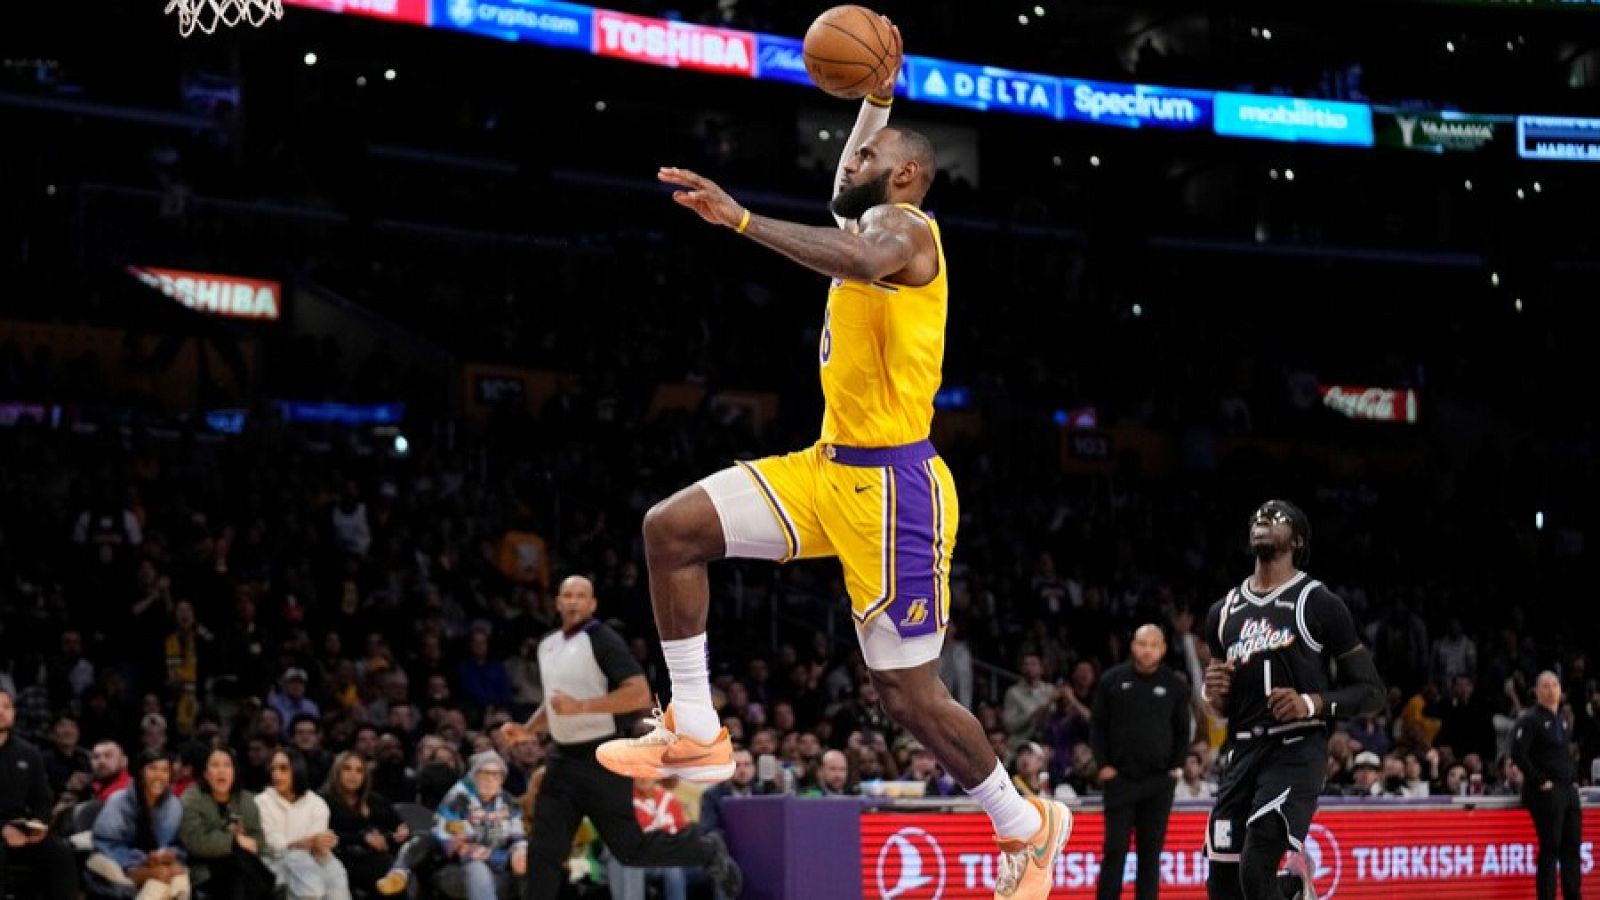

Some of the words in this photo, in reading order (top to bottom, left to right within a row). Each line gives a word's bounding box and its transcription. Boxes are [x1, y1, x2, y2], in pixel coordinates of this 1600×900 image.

[478, 3, 579, 35] crypto.com
[600, 17, 750, 69] TOSHIBA
[953, 72, 1050, 109] DELTA
[1073, 84, 1195, 121] Spectrum
[1263, 659, 1272, 696] 1
[1352, 844, 1475, 880] TURKISH
